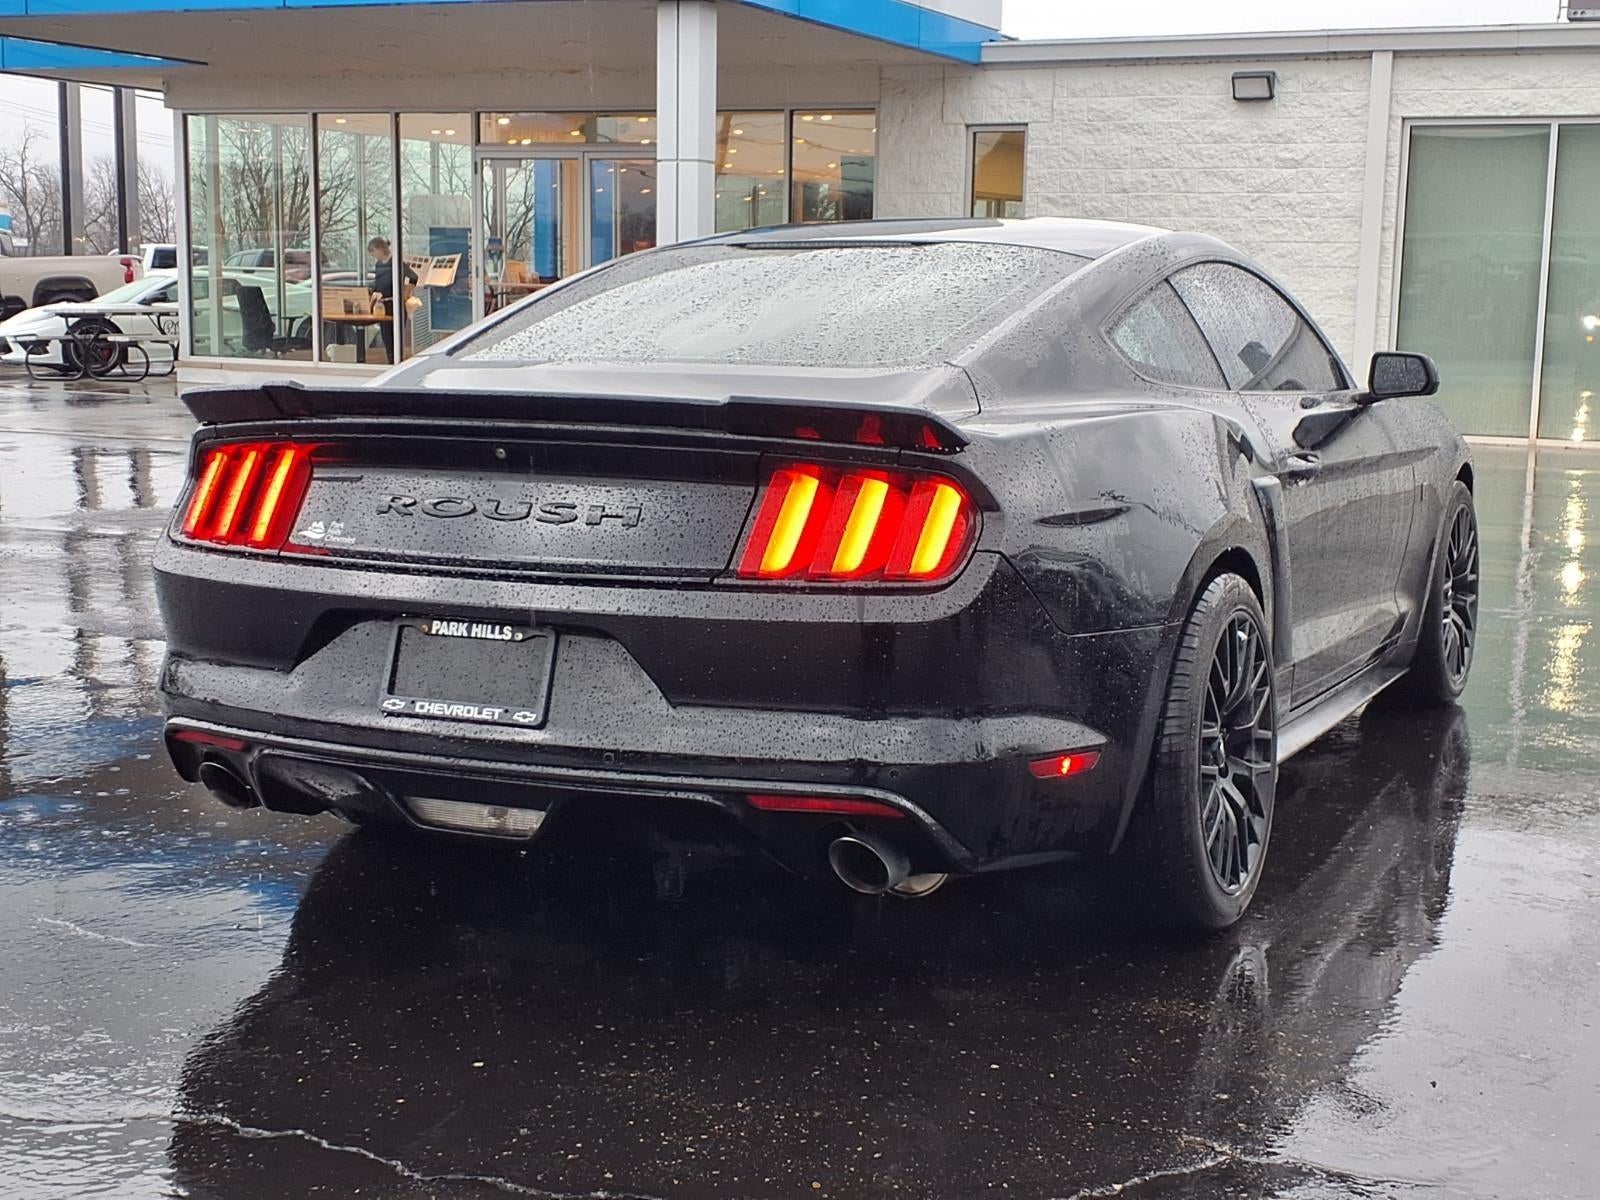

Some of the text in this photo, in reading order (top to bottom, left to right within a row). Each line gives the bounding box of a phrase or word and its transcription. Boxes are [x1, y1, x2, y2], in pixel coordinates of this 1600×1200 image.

[377, 495, 643, 527] ROUSH
[430, 620, 513, 640] PARK HILLS
[415, 702, 503, 720] CHEVROLET
